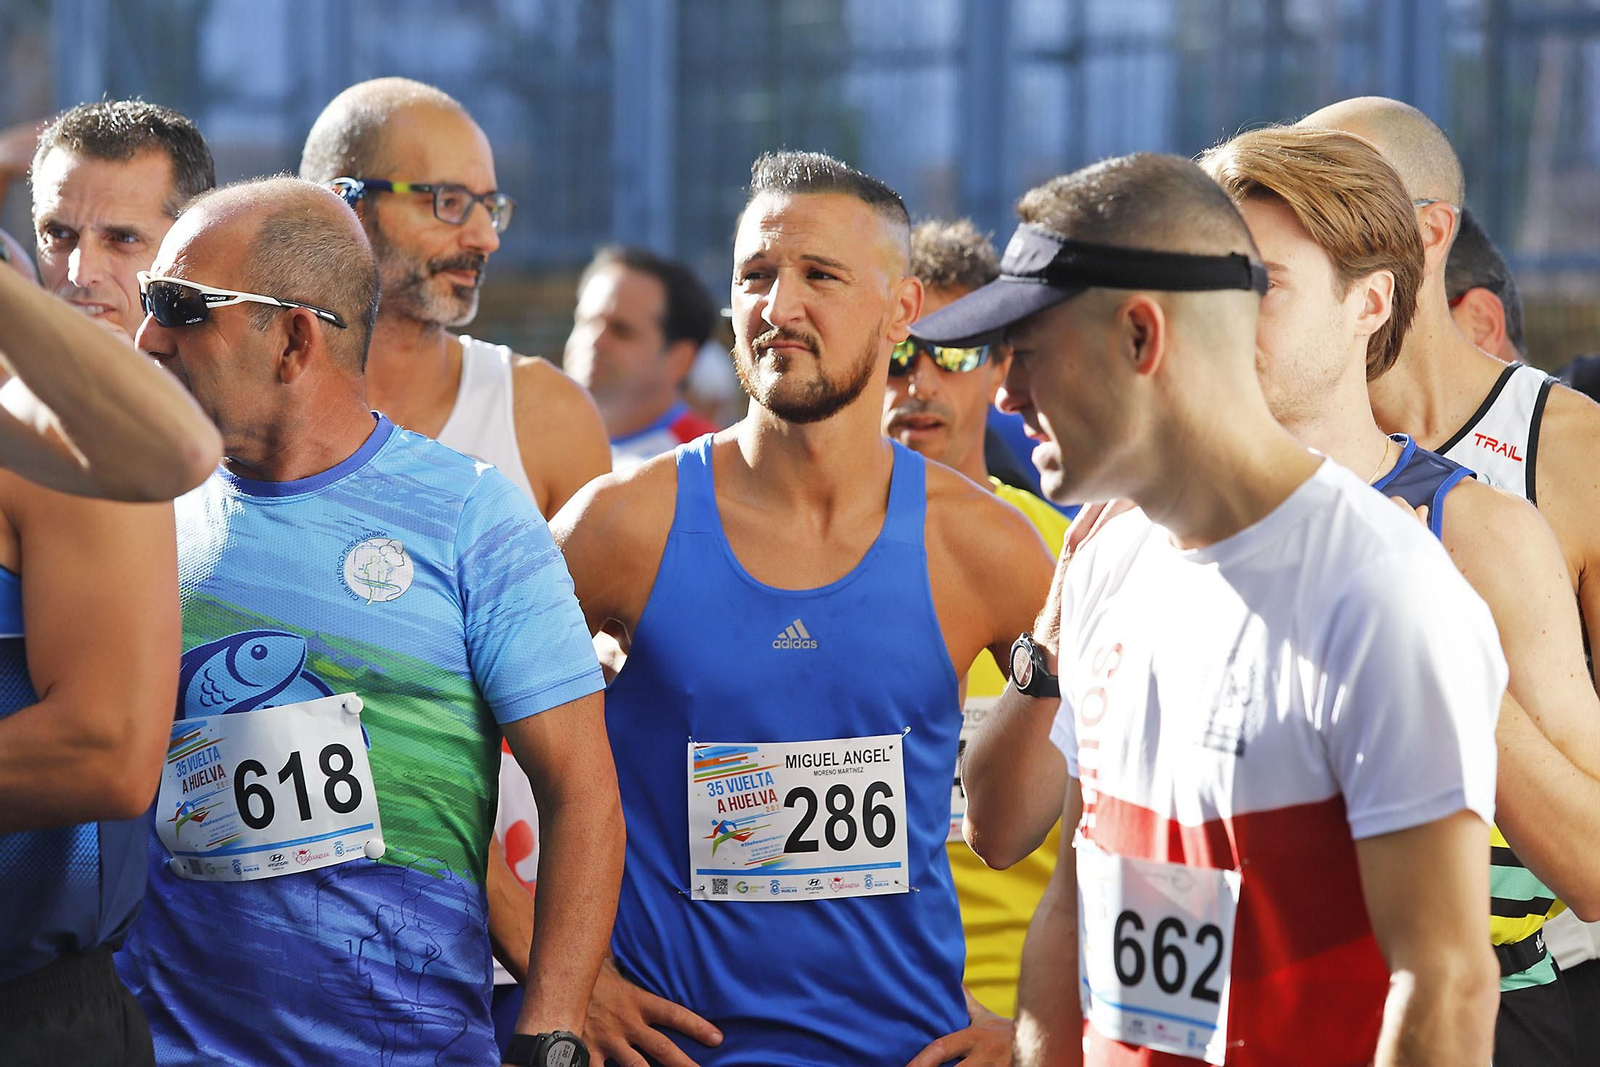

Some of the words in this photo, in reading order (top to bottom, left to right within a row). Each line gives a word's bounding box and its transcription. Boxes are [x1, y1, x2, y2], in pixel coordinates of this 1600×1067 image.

[1474, 432, 1523, 462] TRAIL
[341, 539, 360, 556] PUNTA
[343, 586, 360, 601] CLUB
[772, 637, 818, 649] adidas
[175, 760, 187, 778] 35
[187, 745, 222, 772] VUELTA
[785, 752, 839, 769] MIGUEL
[843, 748, 890, 765] ANGEL
[813, 768, 836, 776] MORENO
[838, 767, 864, 775] MARTINEZ
[182, 778, 189, 794] A
[189, 763, 227, 792] HUELVA
[233, 743, 363, 830] 618
[707, 781, 724, 797] 35
[726, 771, 774, 793] VUELTA
[717, 798, 727, 813] A
[728, 789, 778, 811] HUELVA
[783, 780, 896, 854] 286
[1113, 910, 1224, 1004] 662
